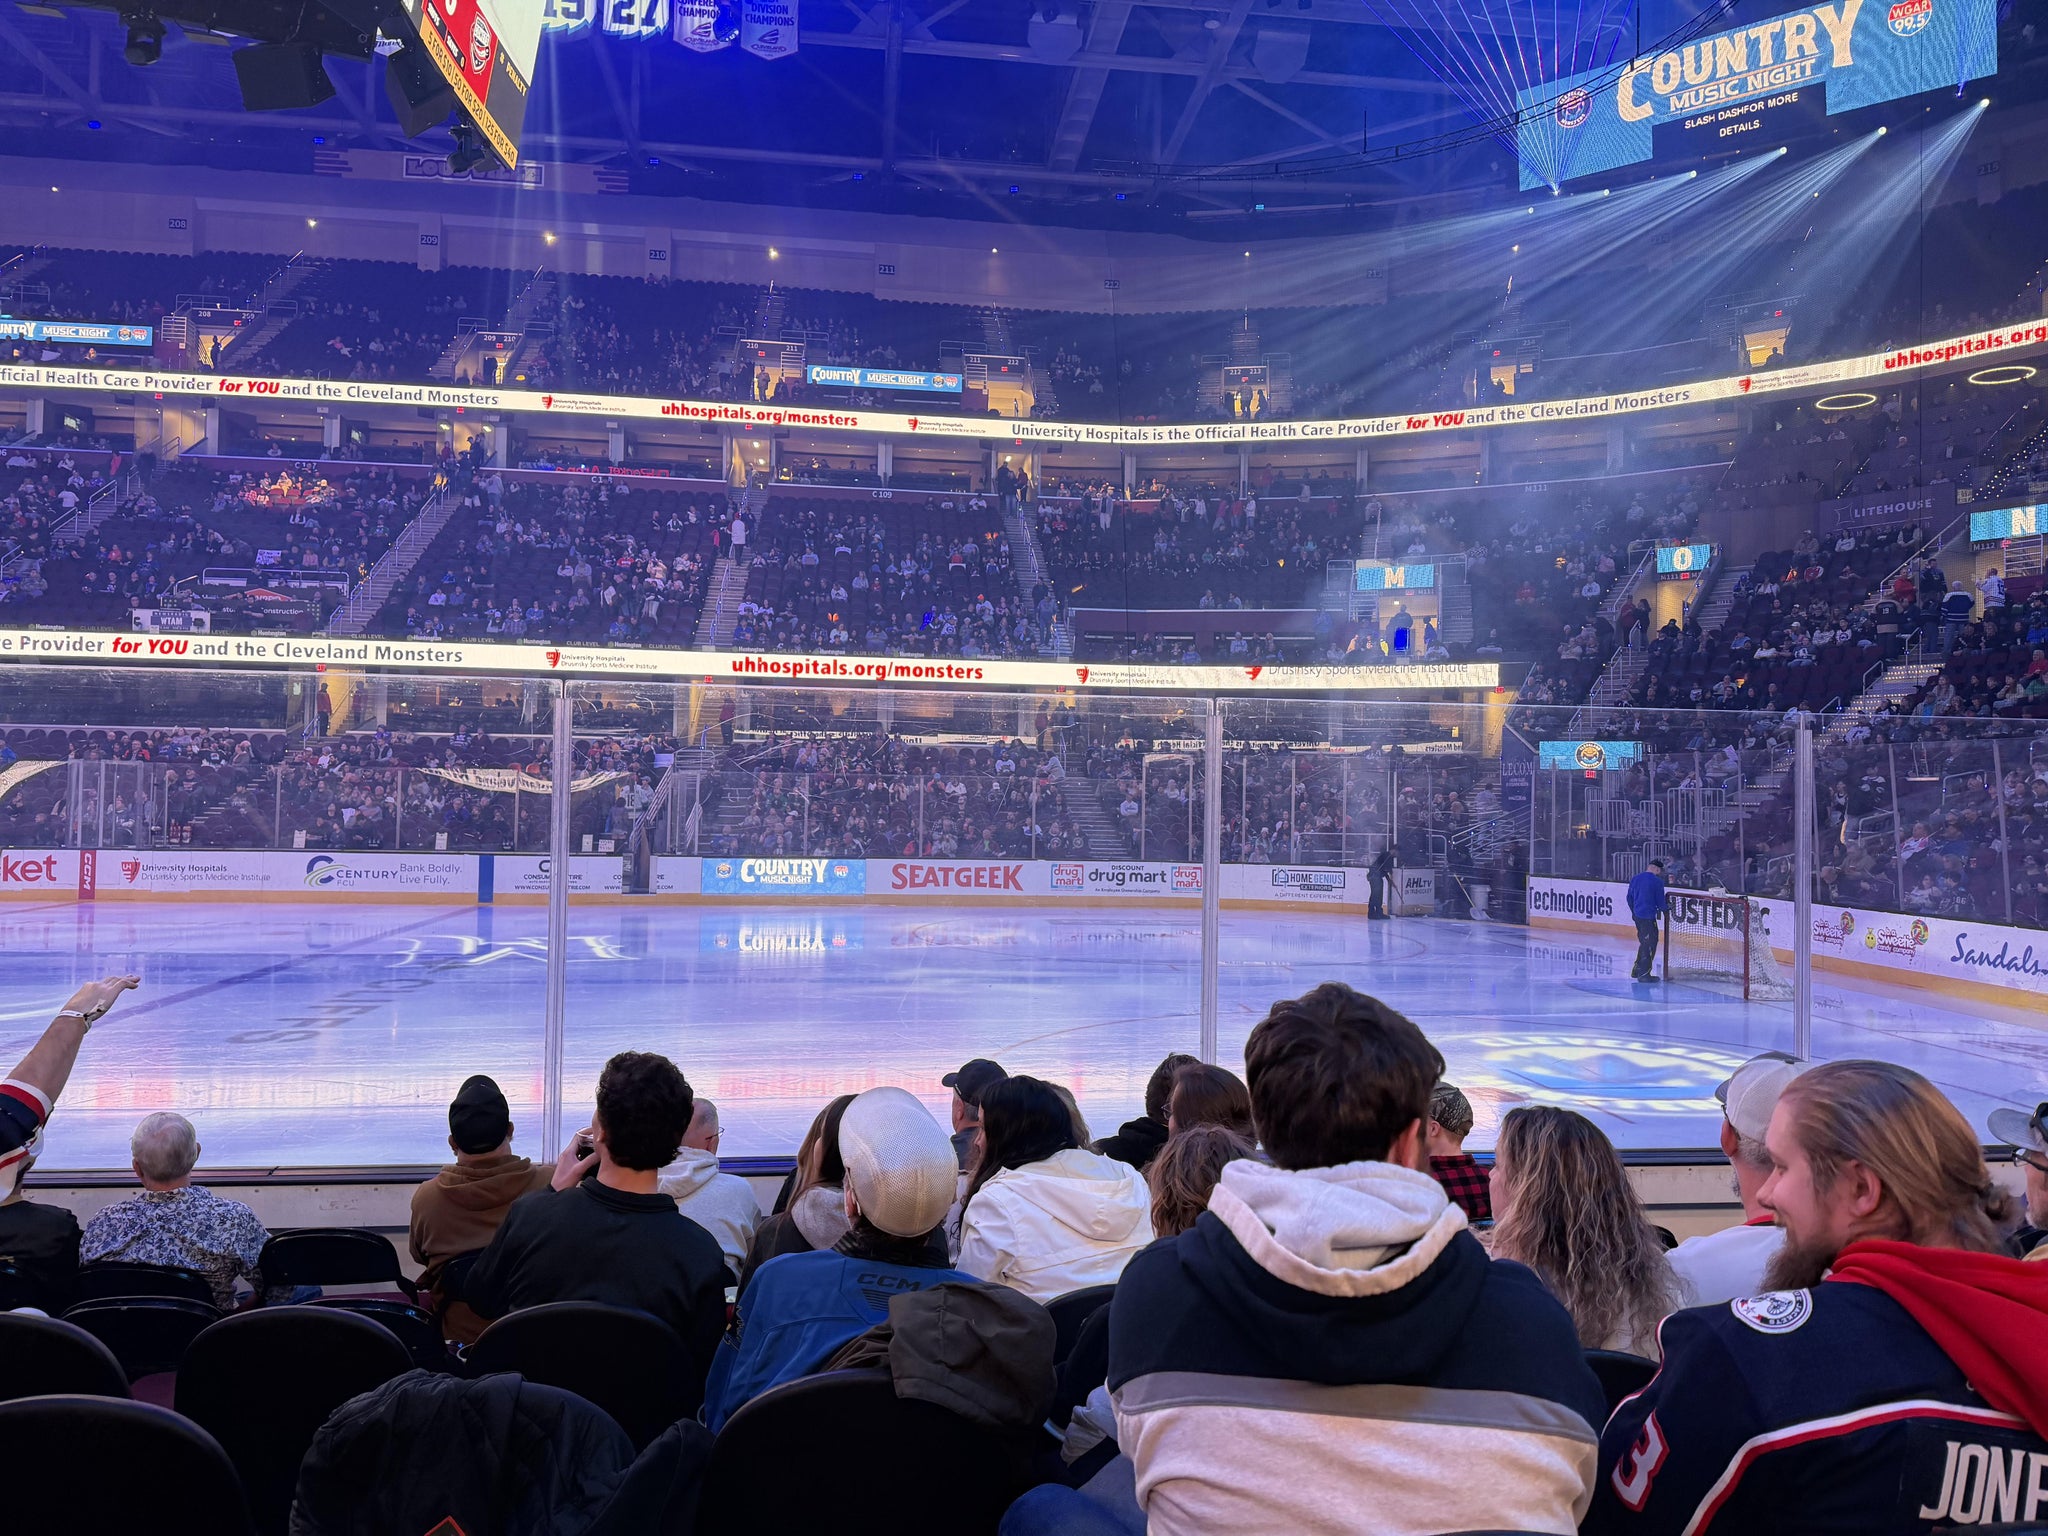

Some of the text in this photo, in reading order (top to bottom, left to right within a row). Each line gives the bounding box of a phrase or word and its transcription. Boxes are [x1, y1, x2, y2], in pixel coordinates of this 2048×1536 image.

[611, 0, 658, 26] 27
[751, 4, 789, 15] DIVISION
[1892, 1, 1928, 19] WGAR
[745, 14, 795, 27] CHAMPIONS
[1894, 13, 1926, 32] 99.5
[1617, 0, 1861, 122] COUNTRY
[427, 31, 433, 44] 5
[432, 40, 445, 61] FOR
[454, 74, 462, 91] 50
[461, 85, 473, 104] FOR
[485, 117, 495, 136] 125
[494, 130, 504, 149] FOR
[1669, 58, 1817, 112] MUSIC NIGHT
[1684, 92, 1799, 129] SLASH DASHFOR MORE
[1719, 119, 1763, 138] DETAILS.
[169, 219, 186, 229] 208
[421, 235, 438, 246] 209
[649, 250, 667, 261] 210
[879, 265, 895, 274] 211
[1104, 280, 1120, 289] 212
[43, 327, 76, 336] MUSIC
[78, 328, 111, 338] NIGHT
[504, 335, 516, 343] 210
[1884, 324, 2048, 370] uhhospitals.org
[812, 367, 926, 385] COUNTRY MUSIC NIGHT
[46, 372, 499, 405] Health Care Provider for YOU and the Cleveland Monsters
[661, 402, 858, 426] uhhospitals.org/monsters
[1012, 389, 1690, 444] University Hospitals is the Official Health Care Provider for YOU and the Cleveland Monsters
[879, 491, 893, 499] 109
[1525, 484, 1548, 492] M111
[1854, 499, 1933, 518] LITEHOUSE
[2011, 507, 2036, 535] N
[1974, 542, 1996, 550] M112
[1673, 547, 1693, 570] O
[1385, 567, 1405, 589] M
[262, 607, 303, 615] onstruction
[161, 617, 183, 625] WTAM
[19, 636, 463, 663] Provider for YOU and the Cleveland Monsters
[561, 654, 594, 662] University
[732, 657, 983, 681] uhhospitals.org/monsters
[1269, 665, 1322, 678] Drusinsky
[1365, 664, 1417, 674] Medicine
[1502, 762, 1533, 776] LECOM
[2, 854, 57, 882] ket
[83, 853, 92, 890] CCM
[142, 864, 228, 873] University Hospitals
[336, 869, 398, 880] CENTURY
[400, 863, 463, 875] Bank Boldly.
[740, 859, 828, 883] COUNTRY
[891, 863, 1024, 891] SEATGEEK
[1054, 868, 1079, 878] drug
[1088, 869, 1167, 885] drug mart
[1174, 869, 1197, 880] drug
[141, 873, 271, 882] Drusinsky Sports Medicine Institute
[337, 879, 355, 887] FCU
[400, 875, 451, 886] Live Fully.
[760, 875, 812, 884] MUSIC NIGHT
[1056, 877, 1084, 885] mart
[1176, 879, 1203, 888] mart
[1529, 886, 1613, 919] Technologies
[1657, 896, 1737, 930] USTED
[1813, 920, 1844, 939] Sweetie
[1878, 929, 1915, 949] Sweetie
[1950, 932, 2042, 976] Sandals
[857, 1273, 921, 1291] CCM
[1611, 1409, 1670, 1512] 3
